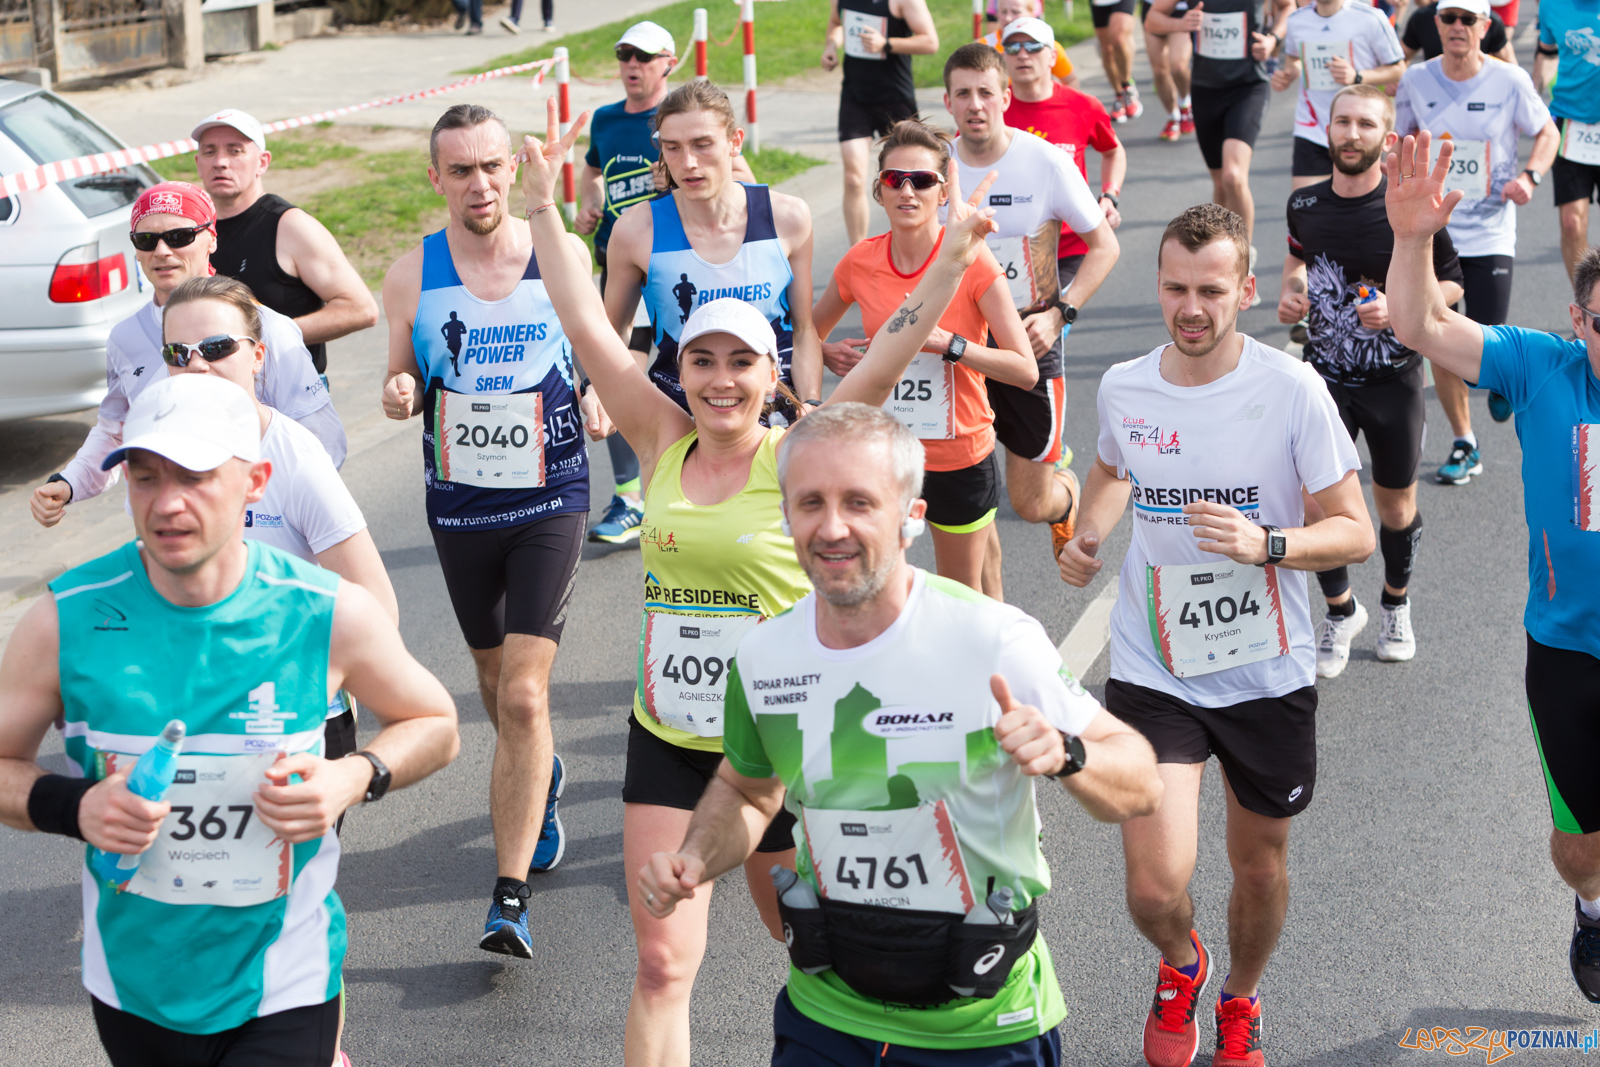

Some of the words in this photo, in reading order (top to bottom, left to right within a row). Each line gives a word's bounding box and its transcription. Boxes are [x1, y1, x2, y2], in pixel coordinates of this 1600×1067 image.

[1203, 27, 1239, 39] 11479
[468, 323, 547, 347] RUNNER'S
[464, 344, 525, 365] POWER
[475, 375, 514, 392] ŚREM
[893, 405, 914, 413] Maria
[1123, 417, 1145, 425] KLUB
[455, 423, 529, 449] 2040
[1148, 426, 1160, 443] 4
[477, 452, 507, 462] Szymon
[1160, 447, 1181, 455] LIFE
[1132, 485, 1142, 502] AP
[1144, 486, 1259, 506] RESIDENCE
[436, 497, 563, 527] www.runnerspower.pl
[645, 586, 661, 601] AP
[663, 588, 760, 609] RESIDENCE
[1179, 590, 1260, 628] 4104
[1204, 627, 1242, 641] Krystian
[753, 678, 781, 690] BOHAR
[784, 673, 821, 688] PALETY
[764, 691, 808, 706] RUNNERS
[875, 712, 954, 726] BOHAR
[169, 805, 253, 841] 367
[168, 850, 230, 863] Wojciech
[836, 853, 929, 890] 4761
[863, 897, 911, 908] MARCIN
